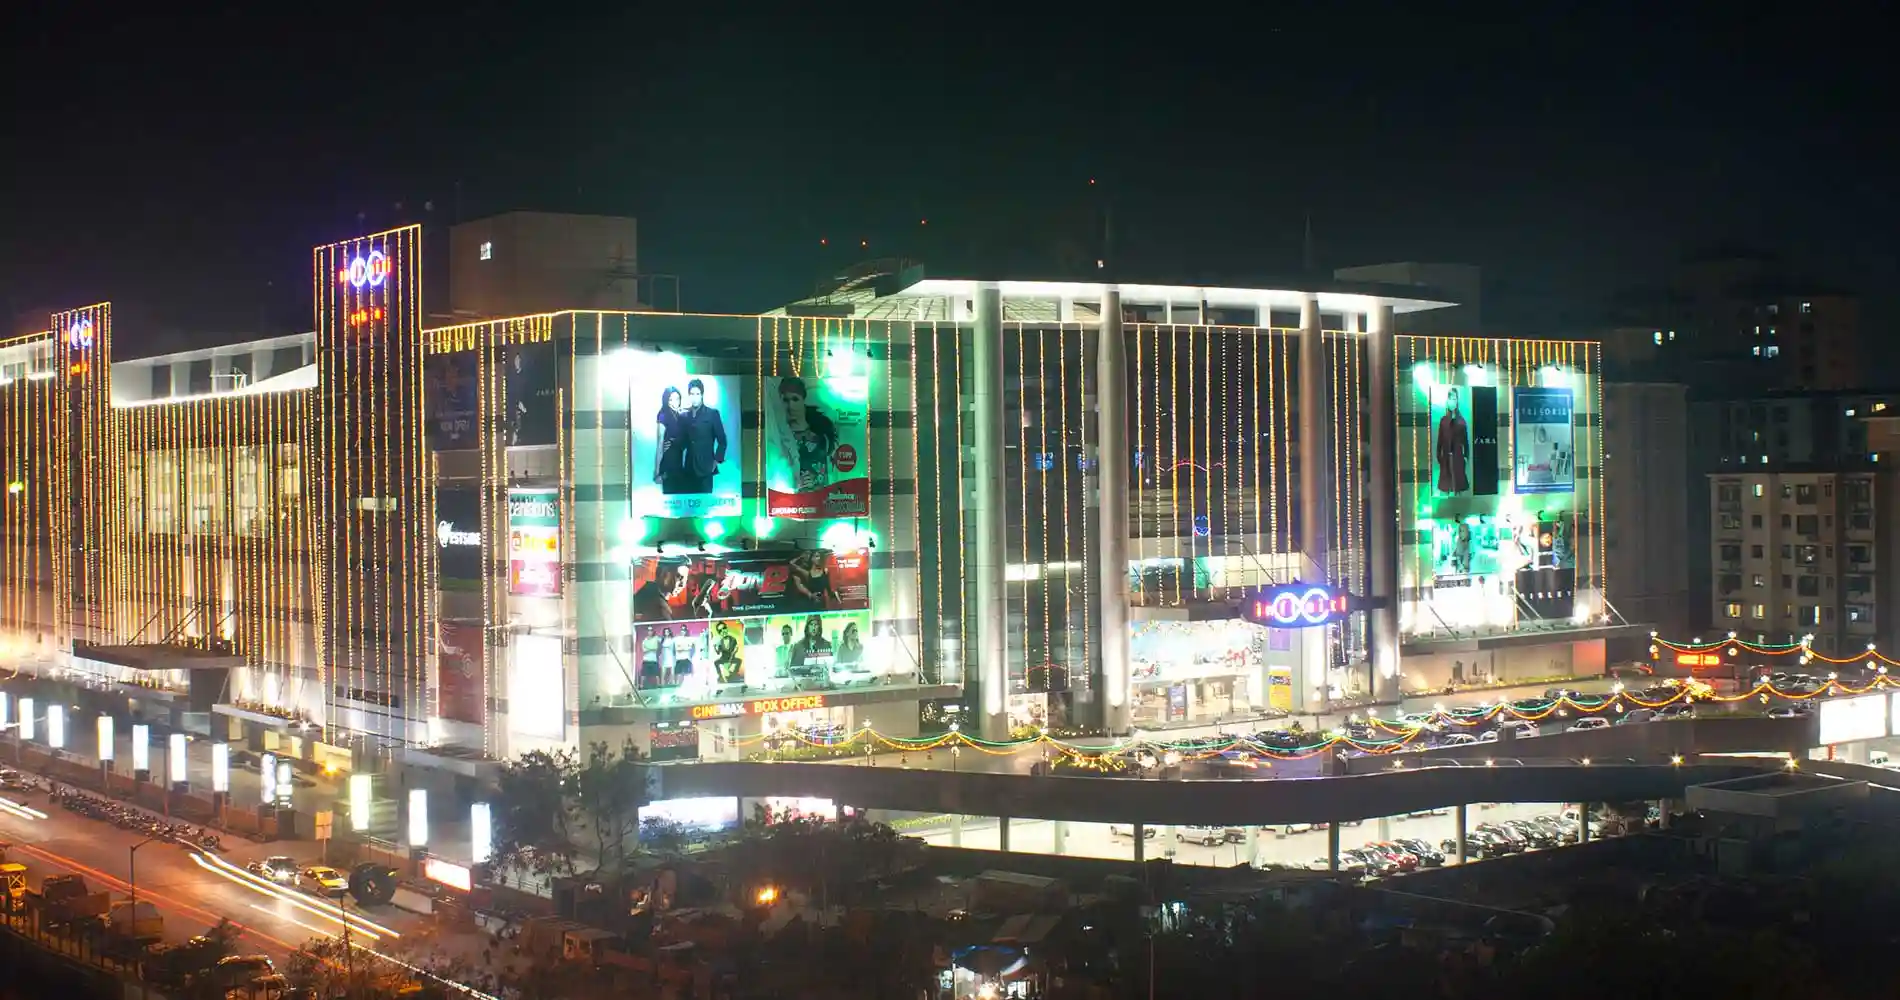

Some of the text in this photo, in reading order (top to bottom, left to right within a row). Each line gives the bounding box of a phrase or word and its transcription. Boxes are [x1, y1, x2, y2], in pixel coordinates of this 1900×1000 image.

[692, 696, 823, 718] CINEMAX BOX OFFICE
